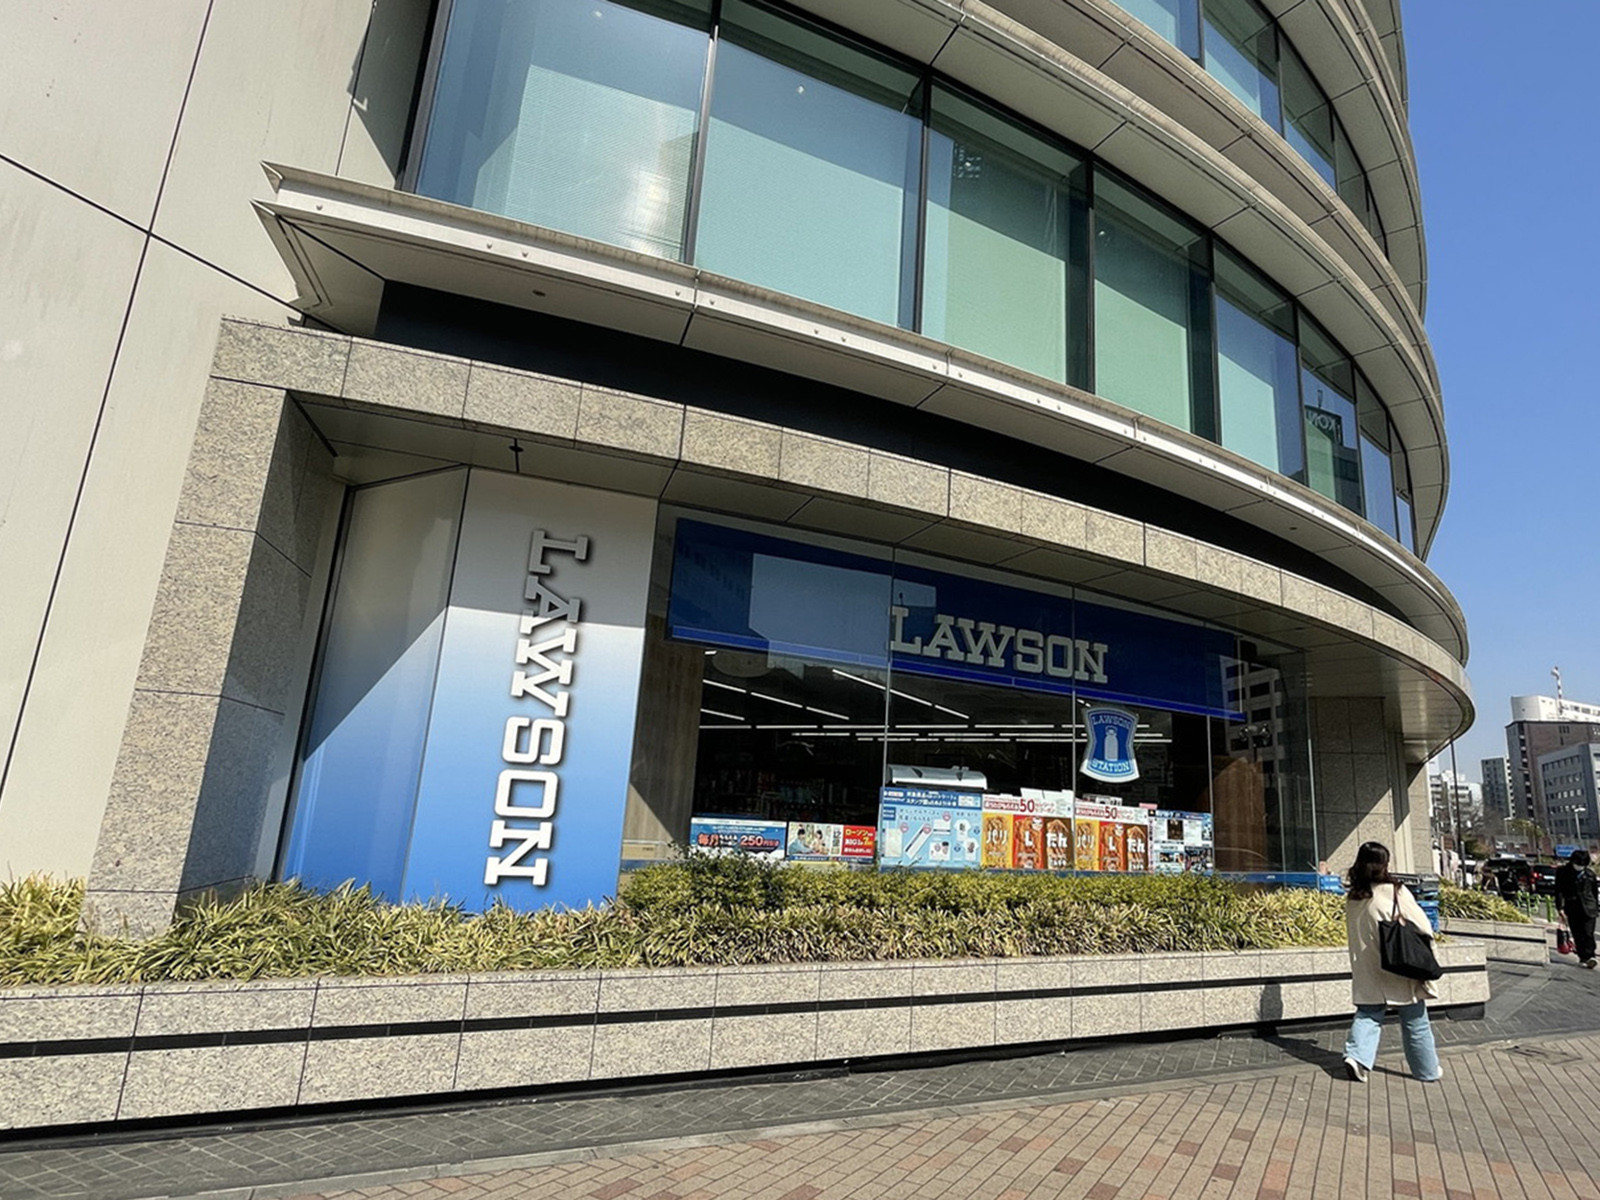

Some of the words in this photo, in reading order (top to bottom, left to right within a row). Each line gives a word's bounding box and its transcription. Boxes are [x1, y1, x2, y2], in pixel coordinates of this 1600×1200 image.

[889, 605, 1109, 685] LAWSON
[484, 528, 589, 887] LAWSON
[1092, 715, 1131, 731] LAWSON
[1092, 758, 1129, 773] STATION
[1019, 799, 1035, 813] 50
[1104, 806, 1118, 820] 50
[1046, 832, 1068, 848] たん
[1126, 837, 1146, 854] たん
